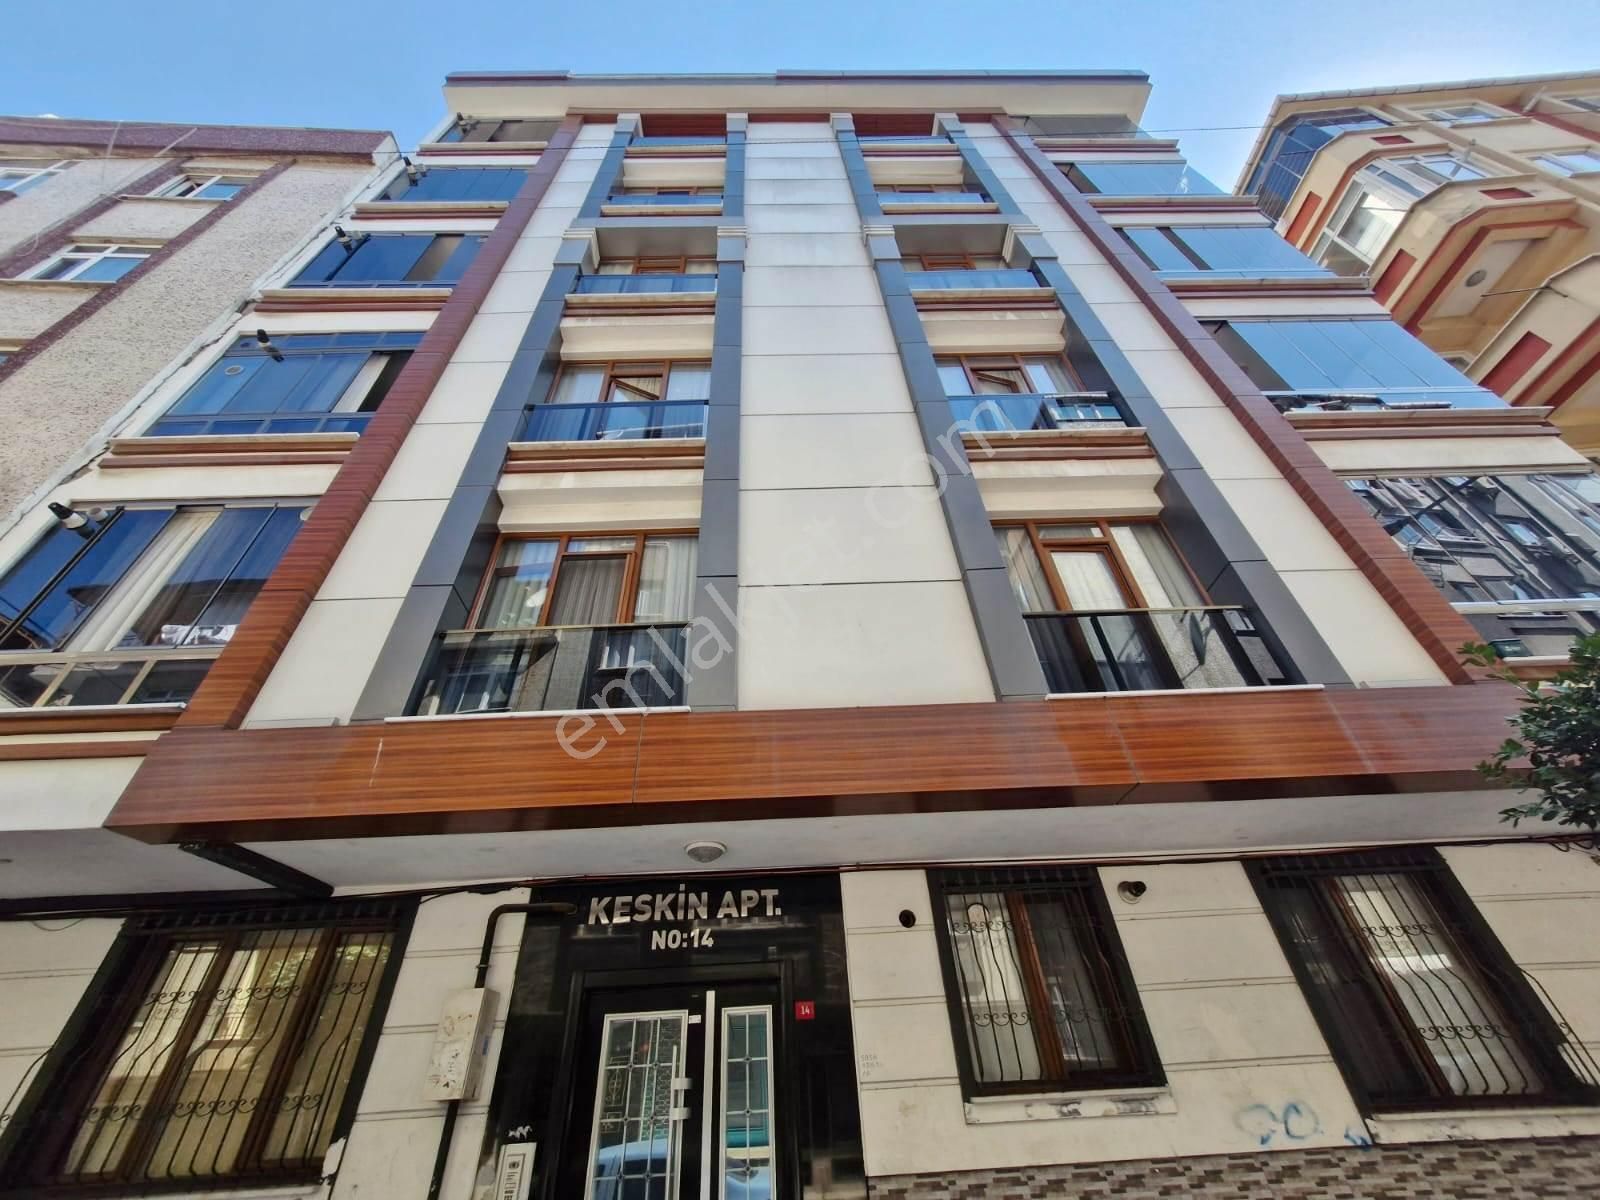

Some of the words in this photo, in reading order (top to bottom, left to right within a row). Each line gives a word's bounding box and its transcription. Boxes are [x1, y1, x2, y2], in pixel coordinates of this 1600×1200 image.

[588, 884, 708, 925] KESKİN
[717, 889, 782, 919] APT.
[651, 928, 714, 950] NO:14
[800, 1005, 810, 1015] 14
